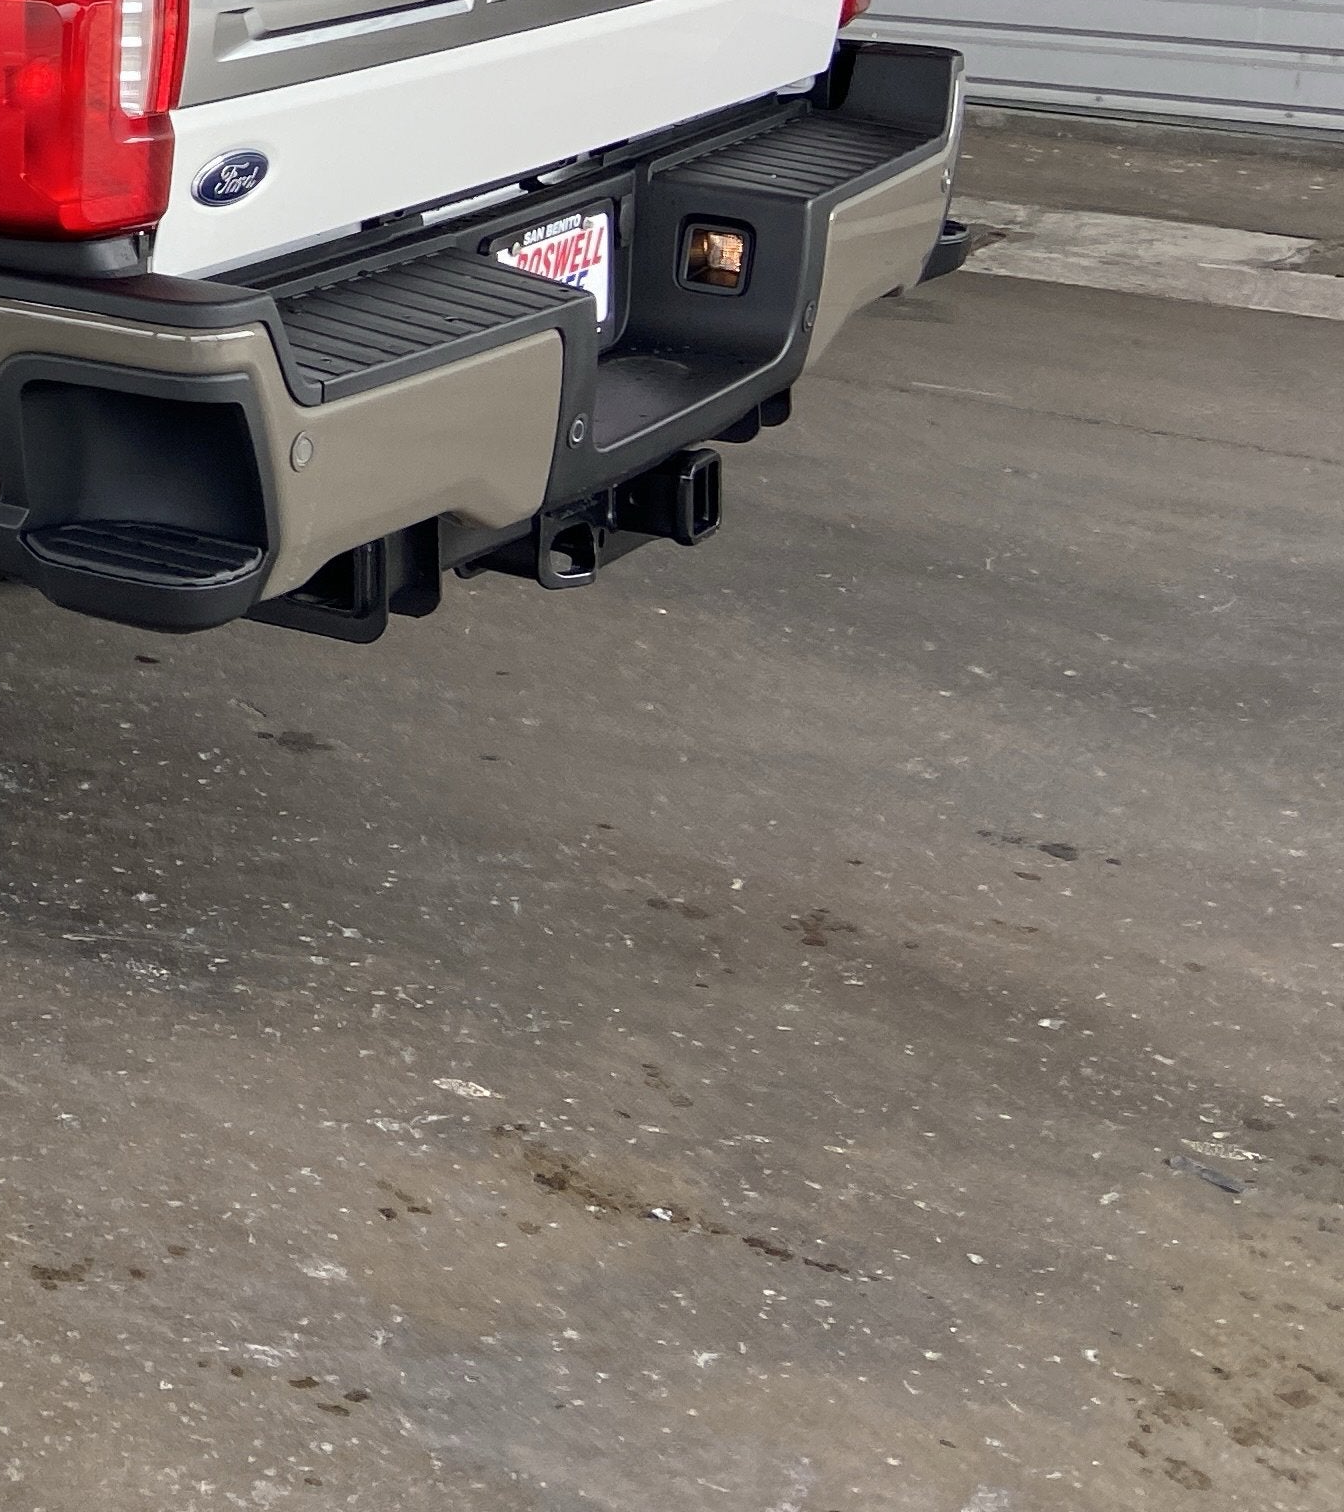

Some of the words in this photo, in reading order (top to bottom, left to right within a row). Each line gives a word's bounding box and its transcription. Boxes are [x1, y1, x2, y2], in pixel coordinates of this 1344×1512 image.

[214, 162, 260, 195] Ford
[524, 226, 545, 246] SAN
[546, 213, 582, 238] BENITO
